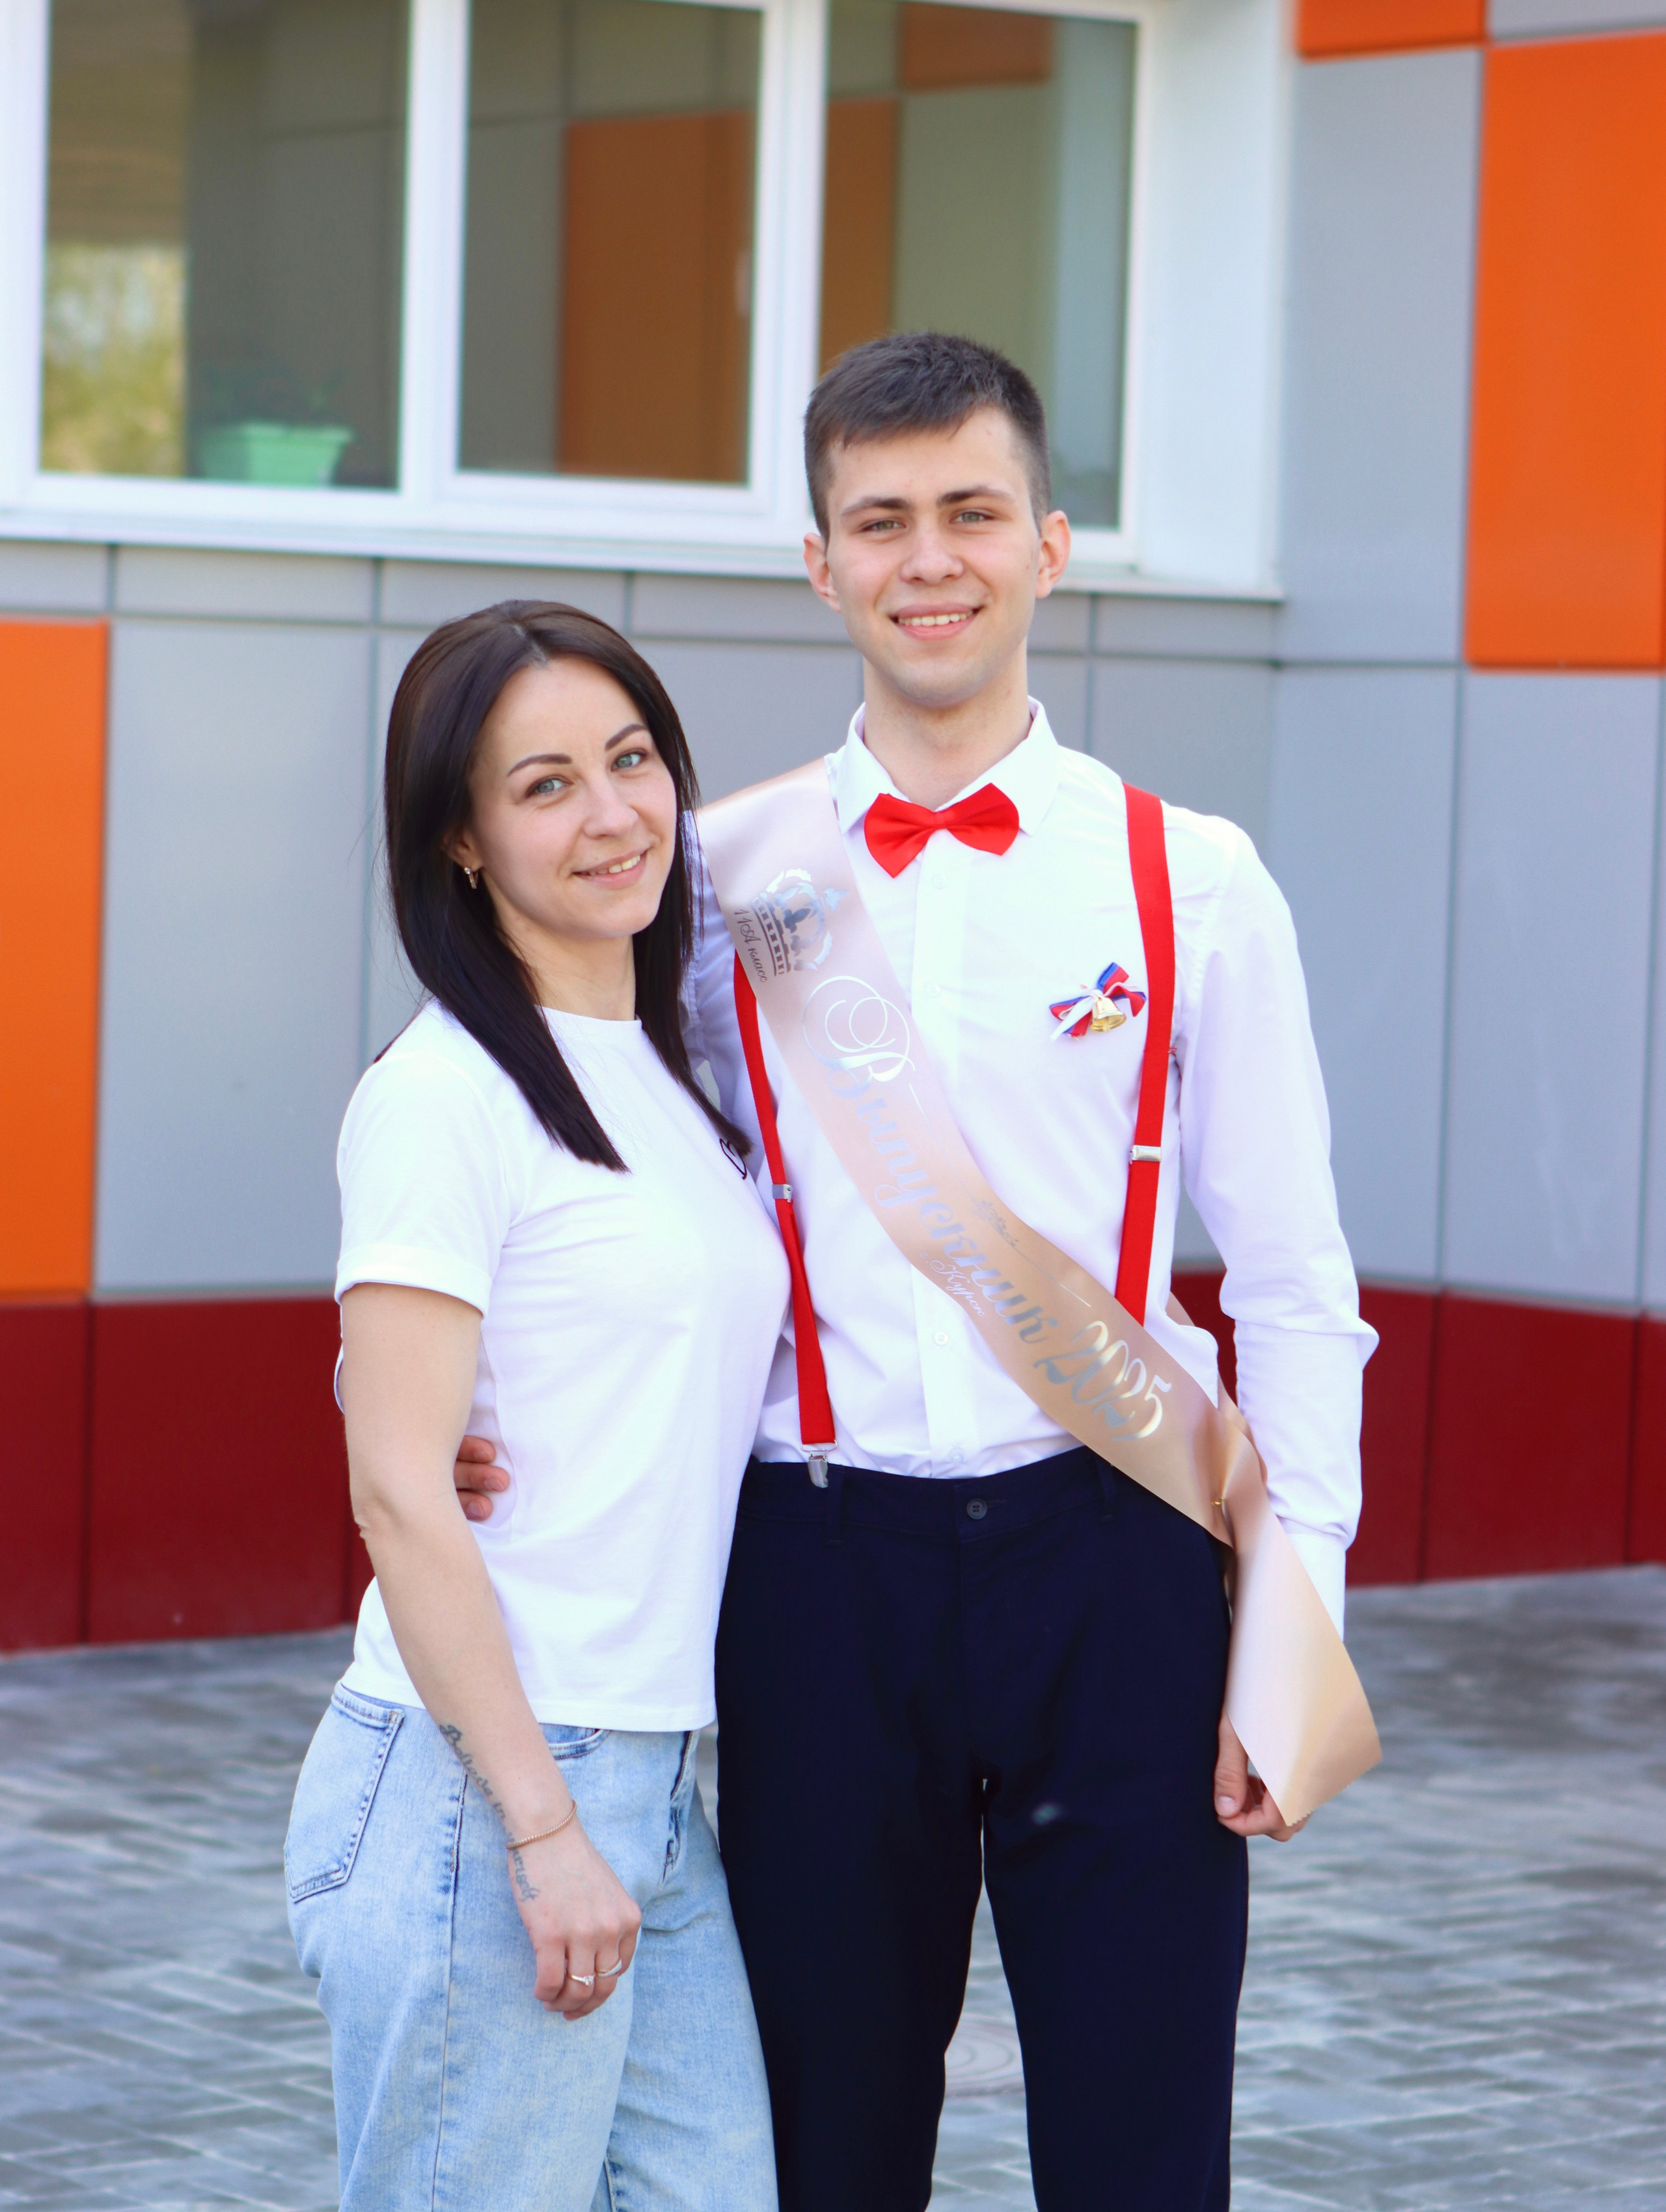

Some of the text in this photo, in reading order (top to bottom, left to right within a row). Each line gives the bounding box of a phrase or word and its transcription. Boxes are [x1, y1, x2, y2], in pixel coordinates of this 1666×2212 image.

[748, 948, 767, 983] класс
[803, 976, 1171, 1441] Выпускник 2025
[931, 1260, 985, 1317] Курск
[493, 1801, 506, 1820] in
